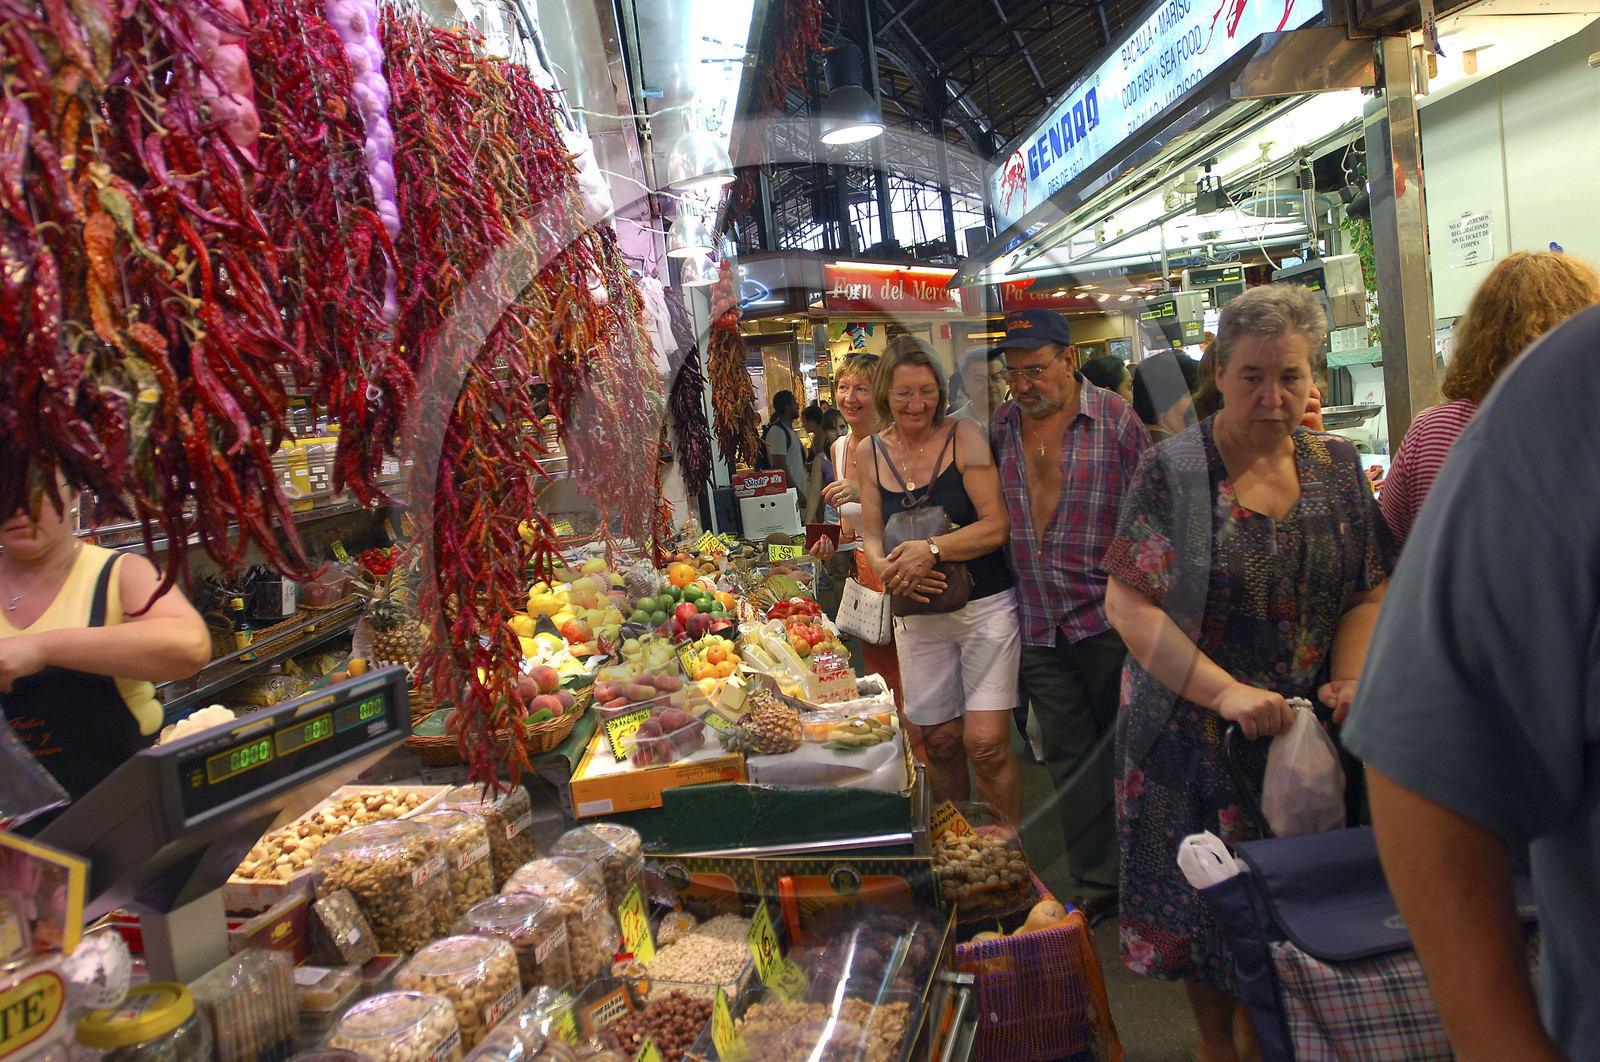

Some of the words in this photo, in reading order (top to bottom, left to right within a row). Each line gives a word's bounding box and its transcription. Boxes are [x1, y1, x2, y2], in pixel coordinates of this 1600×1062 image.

[1122, 80, 1137, 110] COD
[1137, 65, 1155, 97] FISH
[1159, 46, 1177, 79] SEA
[1176, 24, 1202, 65] FOOD
[1027, 86, 1100, 181] GENARO
[1460, 240, 1480, 250] COMPRA
[1465, 232, 1482, 241] TICKET
[832, 276, 873, 301] Forn
[880, 278, 905, 300] del
